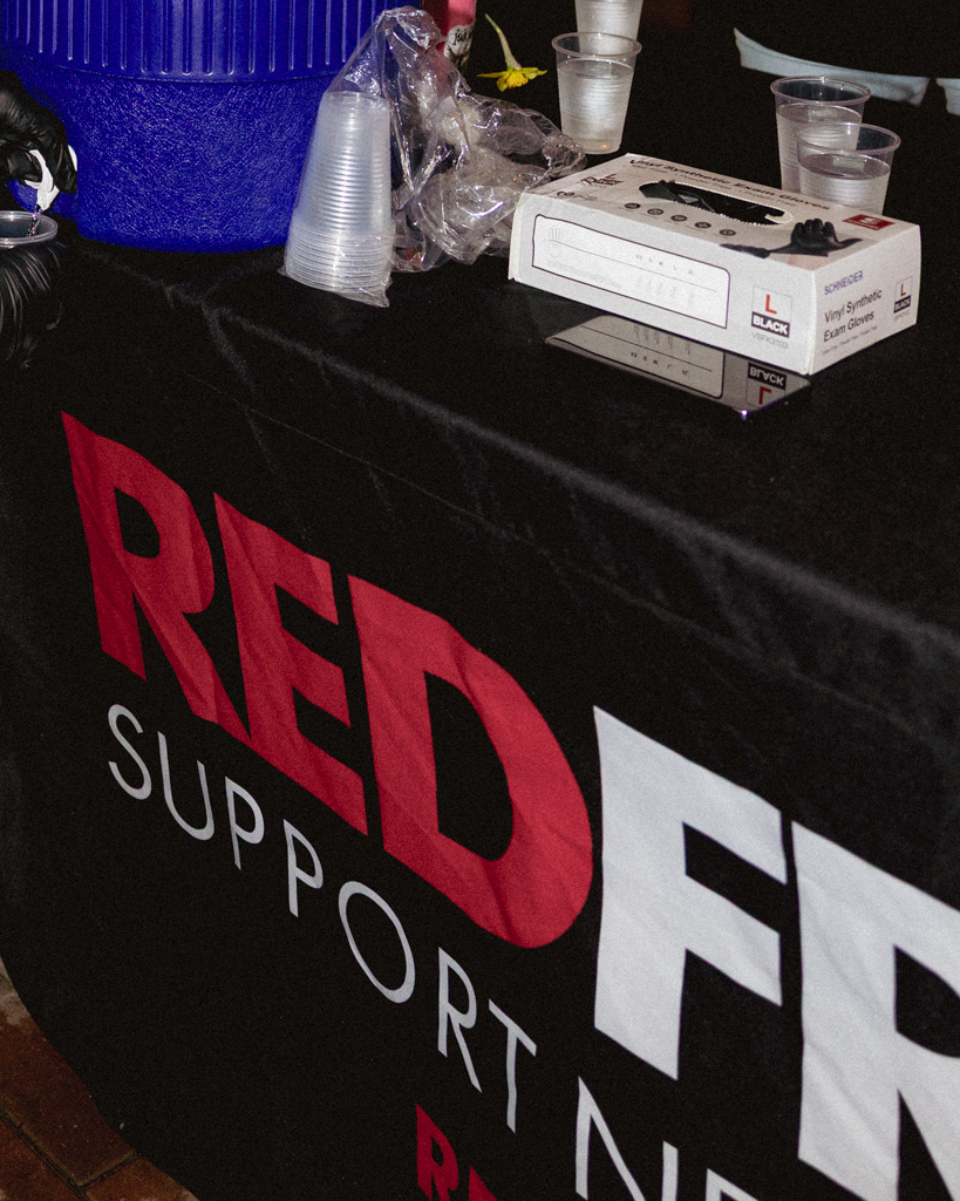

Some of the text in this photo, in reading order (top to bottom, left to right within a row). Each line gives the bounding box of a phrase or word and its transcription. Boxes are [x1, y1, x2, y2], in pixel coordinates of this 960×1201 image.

[733, 182, 776, 197] Exam
[779, 194, 831, 210] Gloves
[765, 293, 778, 315] L
[900, 283, 907, 297] L
[824, 289, 882, 323] Vinyl Synthetic
[753, 314, 788, 335] BLACK
[823, 325, 846, 342] Exam
[847, 311, 875, 331] Gloves
[108, 704, 537, 1133] SUPPORT
